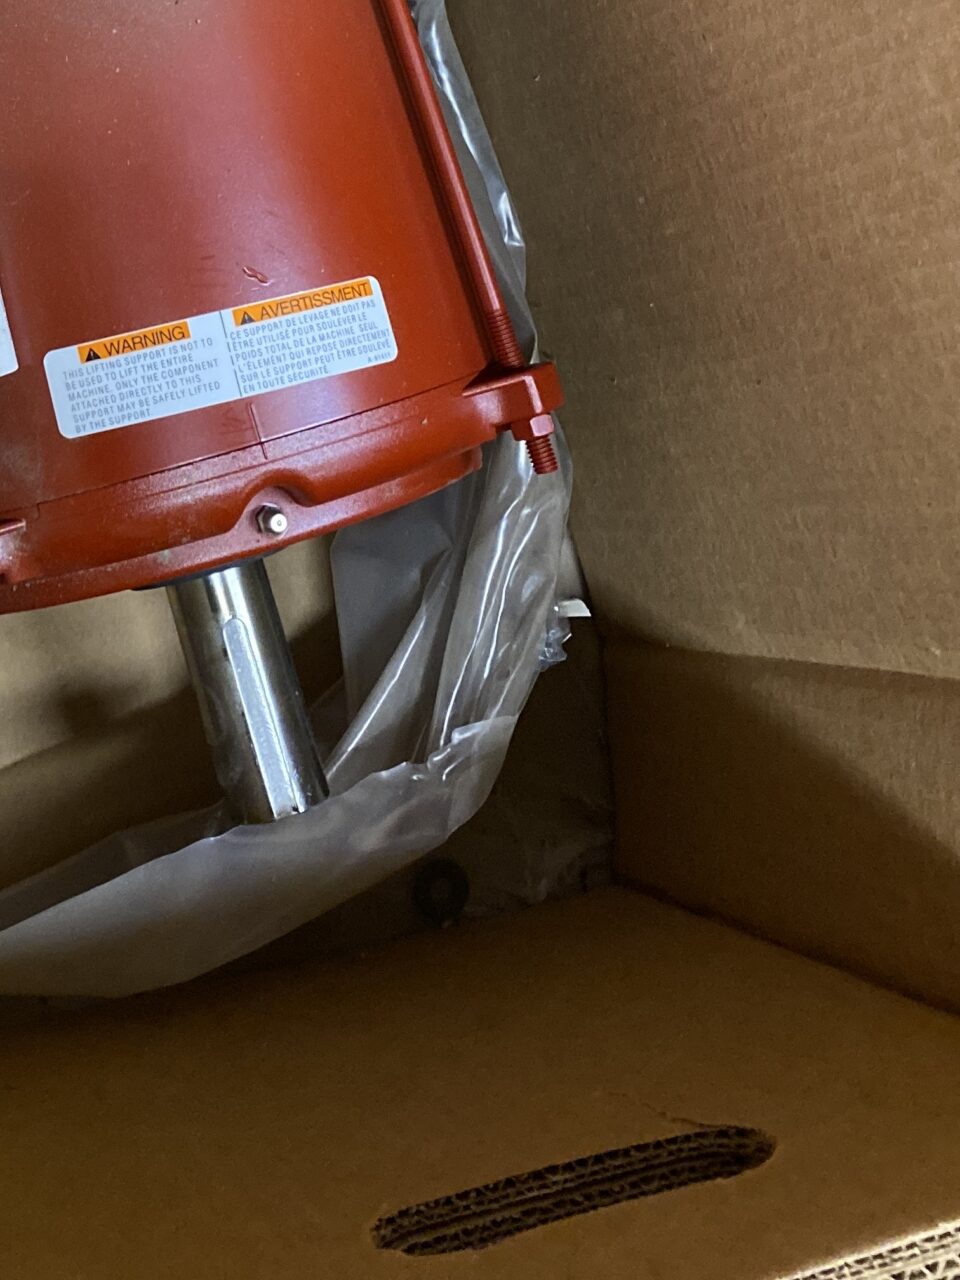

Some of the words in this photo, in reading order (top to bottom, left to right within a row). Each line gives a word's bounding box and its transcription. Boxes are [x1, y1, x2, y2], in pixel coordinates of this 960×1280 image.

[258, 281, 369, 320] AVERTISSMENT
[229, 329, 242, 340] CE
[243, 320, 283, 337] SUPPORT
[284, 316, 296, 327] DE
[331, 306, 341, 316] NE
[341, 302, 360, 314] DOIT
[361, 298, 375, 309] PAS
[291, 324, 314, 337] POUR
[357, 312, 367, 322] LE
[103, 325, 185, 356] WARNING
[234, 347, 263, 361] POIDS
[264, 340, 291, 354] TOTAL
[293, 337, 304, 348] DE
[306, 334, 316, 345] LA
[358, 320, 378, 333] SEUL
[289, 348, 304, 360] QUI
[305, 341, 337, 356] REPOSE
[338, 329, 390, 349] DIRECTEMENT
[63, 367, 83, 379] THIS
[85, 358, 121, 374] LIFTING
[123, 348, 166, 365] SUPPORT
[168, 345, 178, 355] IS
[180, 340, 198, 352] NOT
[200, 337, 213, 347] TO
[65, 380, 77, 390] BE
[78, 374, 102, 387] USED
[104, 371, 116, 381] TO
[118, 365, 139, 378] LIFT
[141, 361, 158, 373] THE
[160, 353, 193, 368] ENTIRE
[114, 377, 138, 390] ONLY
[141, 372, 158, 384] THE
[160, 358, 219, 379] COMPONENT
[240, 370, 259, 383] SUR
[260, 368, 271, 378] LE
[272, 358, 312, 375] SUPPORT
[314, 353, 335, 366] PEUT
[70, 393, 117, 412] ATTACHED
[118, 382, 163, 401] DIRECTLY
[166, 379, 177, 390] TO
[179, 374, 201, 386] THIS
[243, 382, 255, 393] EN
[256, 375, 285, 390] TOUTE
[72, 405, 114, 422] SUPPORT
[116, 400, 136, 412] MAY
[137, 397, 150, 407] BE
[151, 388, 186, 404] SAFELY
[187, 381, 220, 396] LIFTED
[75, 422, 86, 433] BY
[89, 418, 107, 429] THE
